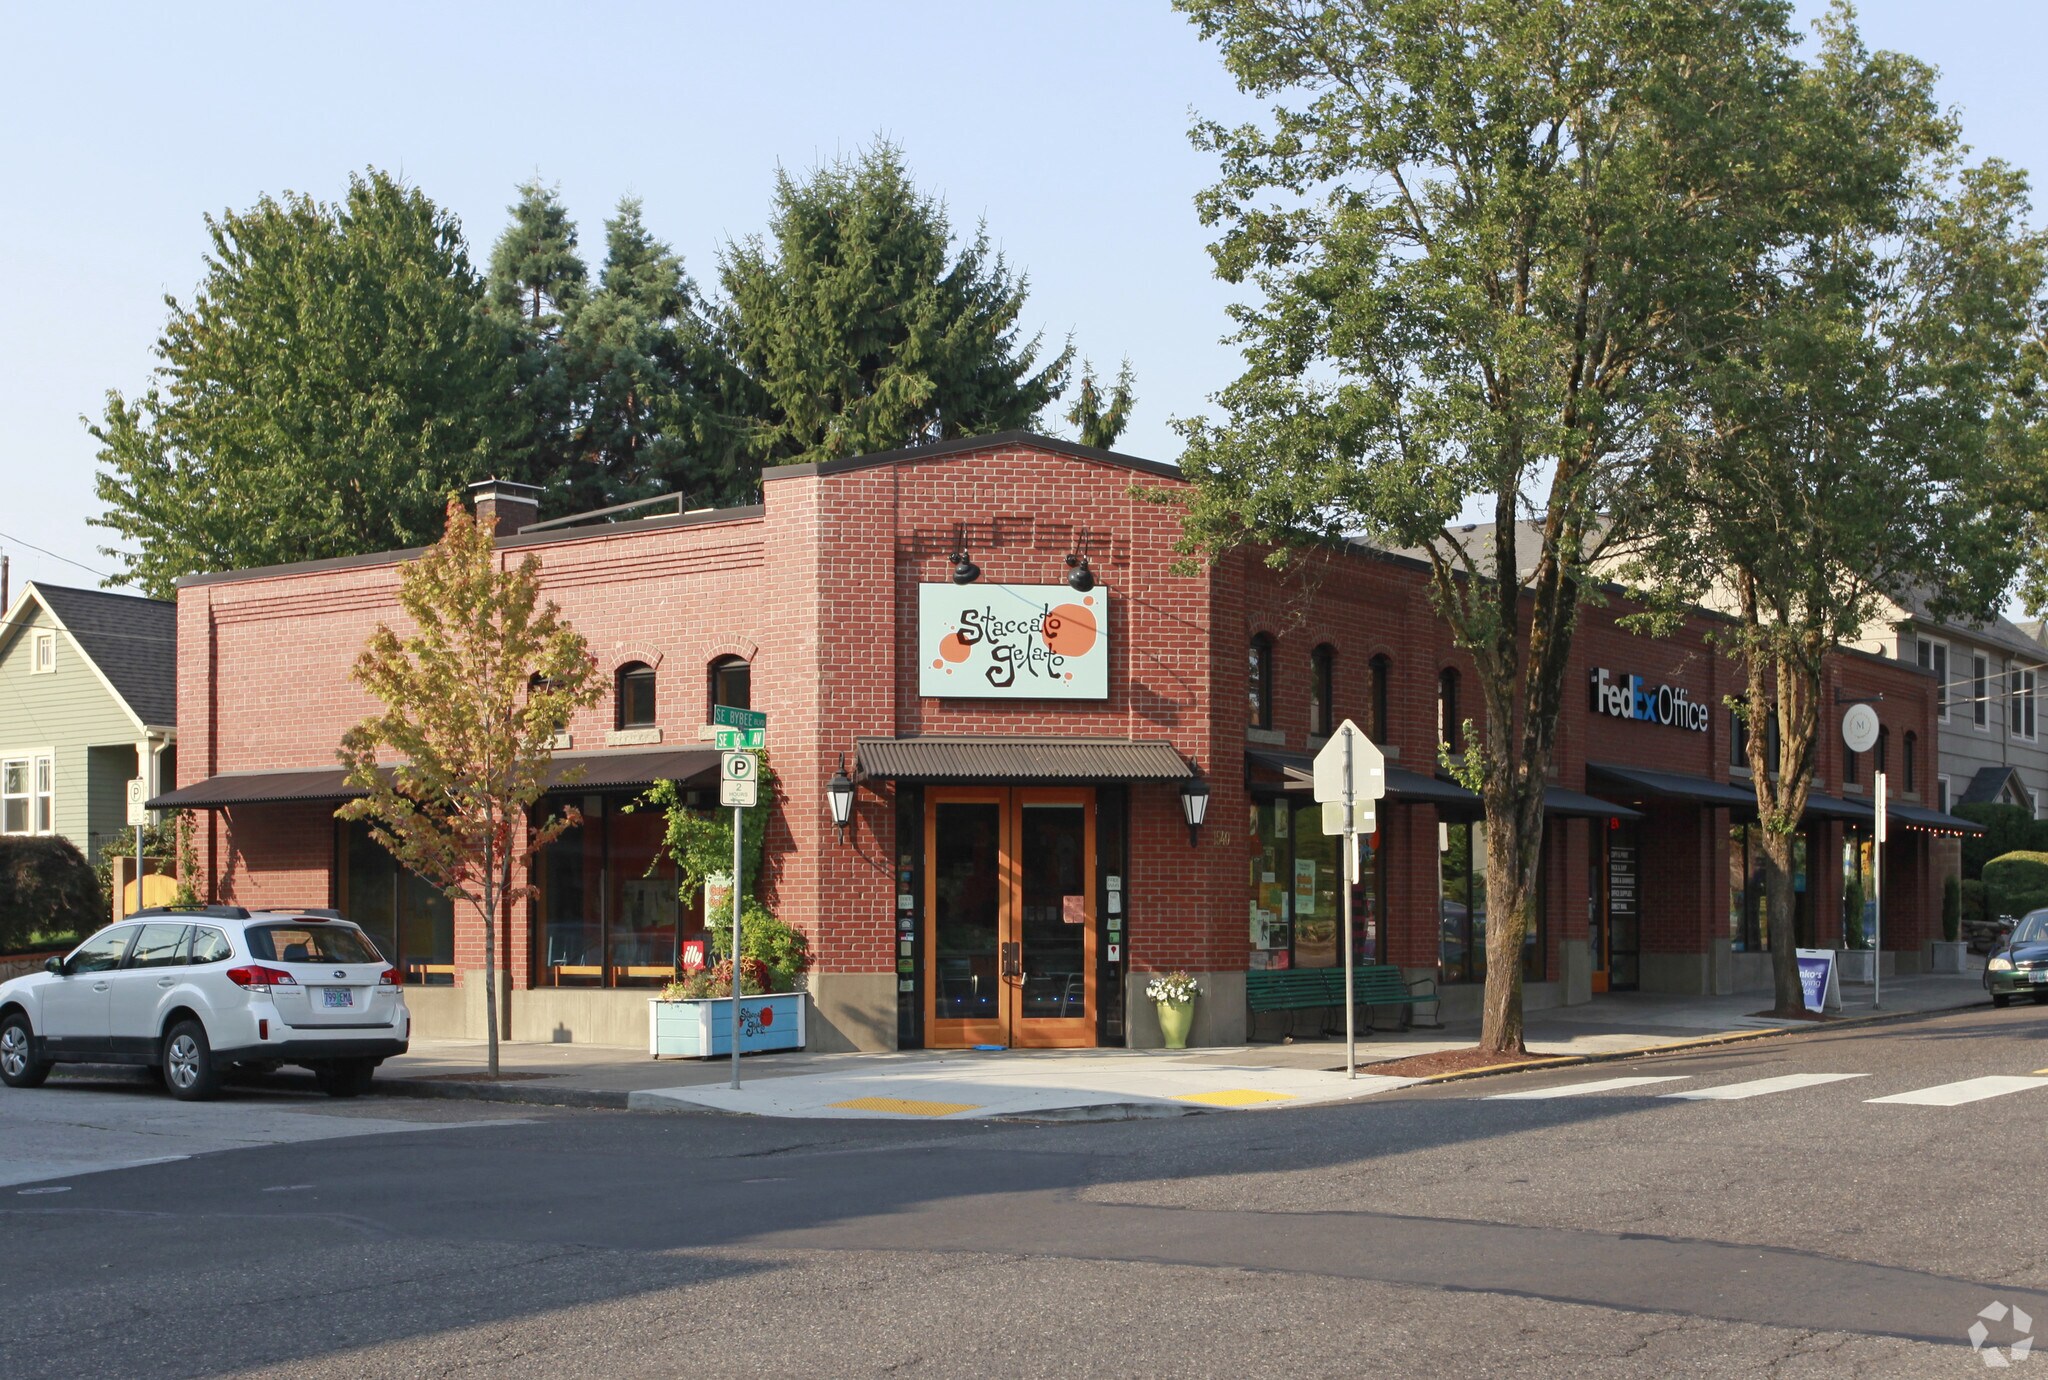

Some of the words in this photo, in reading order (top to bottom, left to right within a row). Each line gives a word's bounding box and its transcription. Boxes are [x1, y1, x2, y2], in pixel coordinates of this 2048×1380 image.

[957, 603, 1061, 646] Staccato
[985, 633, 1065, 688] gelato
[1598, 667, 1658, 723] FedEx
[1658, 684, 1709, 732] Office
[716, 708, 726, 722] SE
[730, 710, 753, 727] BYBEE
[1856, 721, 1865, 730] M
[718, 733, 728, 747] SE
[752, 732, 762, 746] AV
[734, 760, 747, 775] P
[133, 787, 140, 799] P
[736, 783, 742, 792] 2
[683, 945, 702, 967] illy
[1800, 970, 1822, 978] nko's
[1802, 979, 1821, 989] ying
[324, 992, 337, 1002] 799
